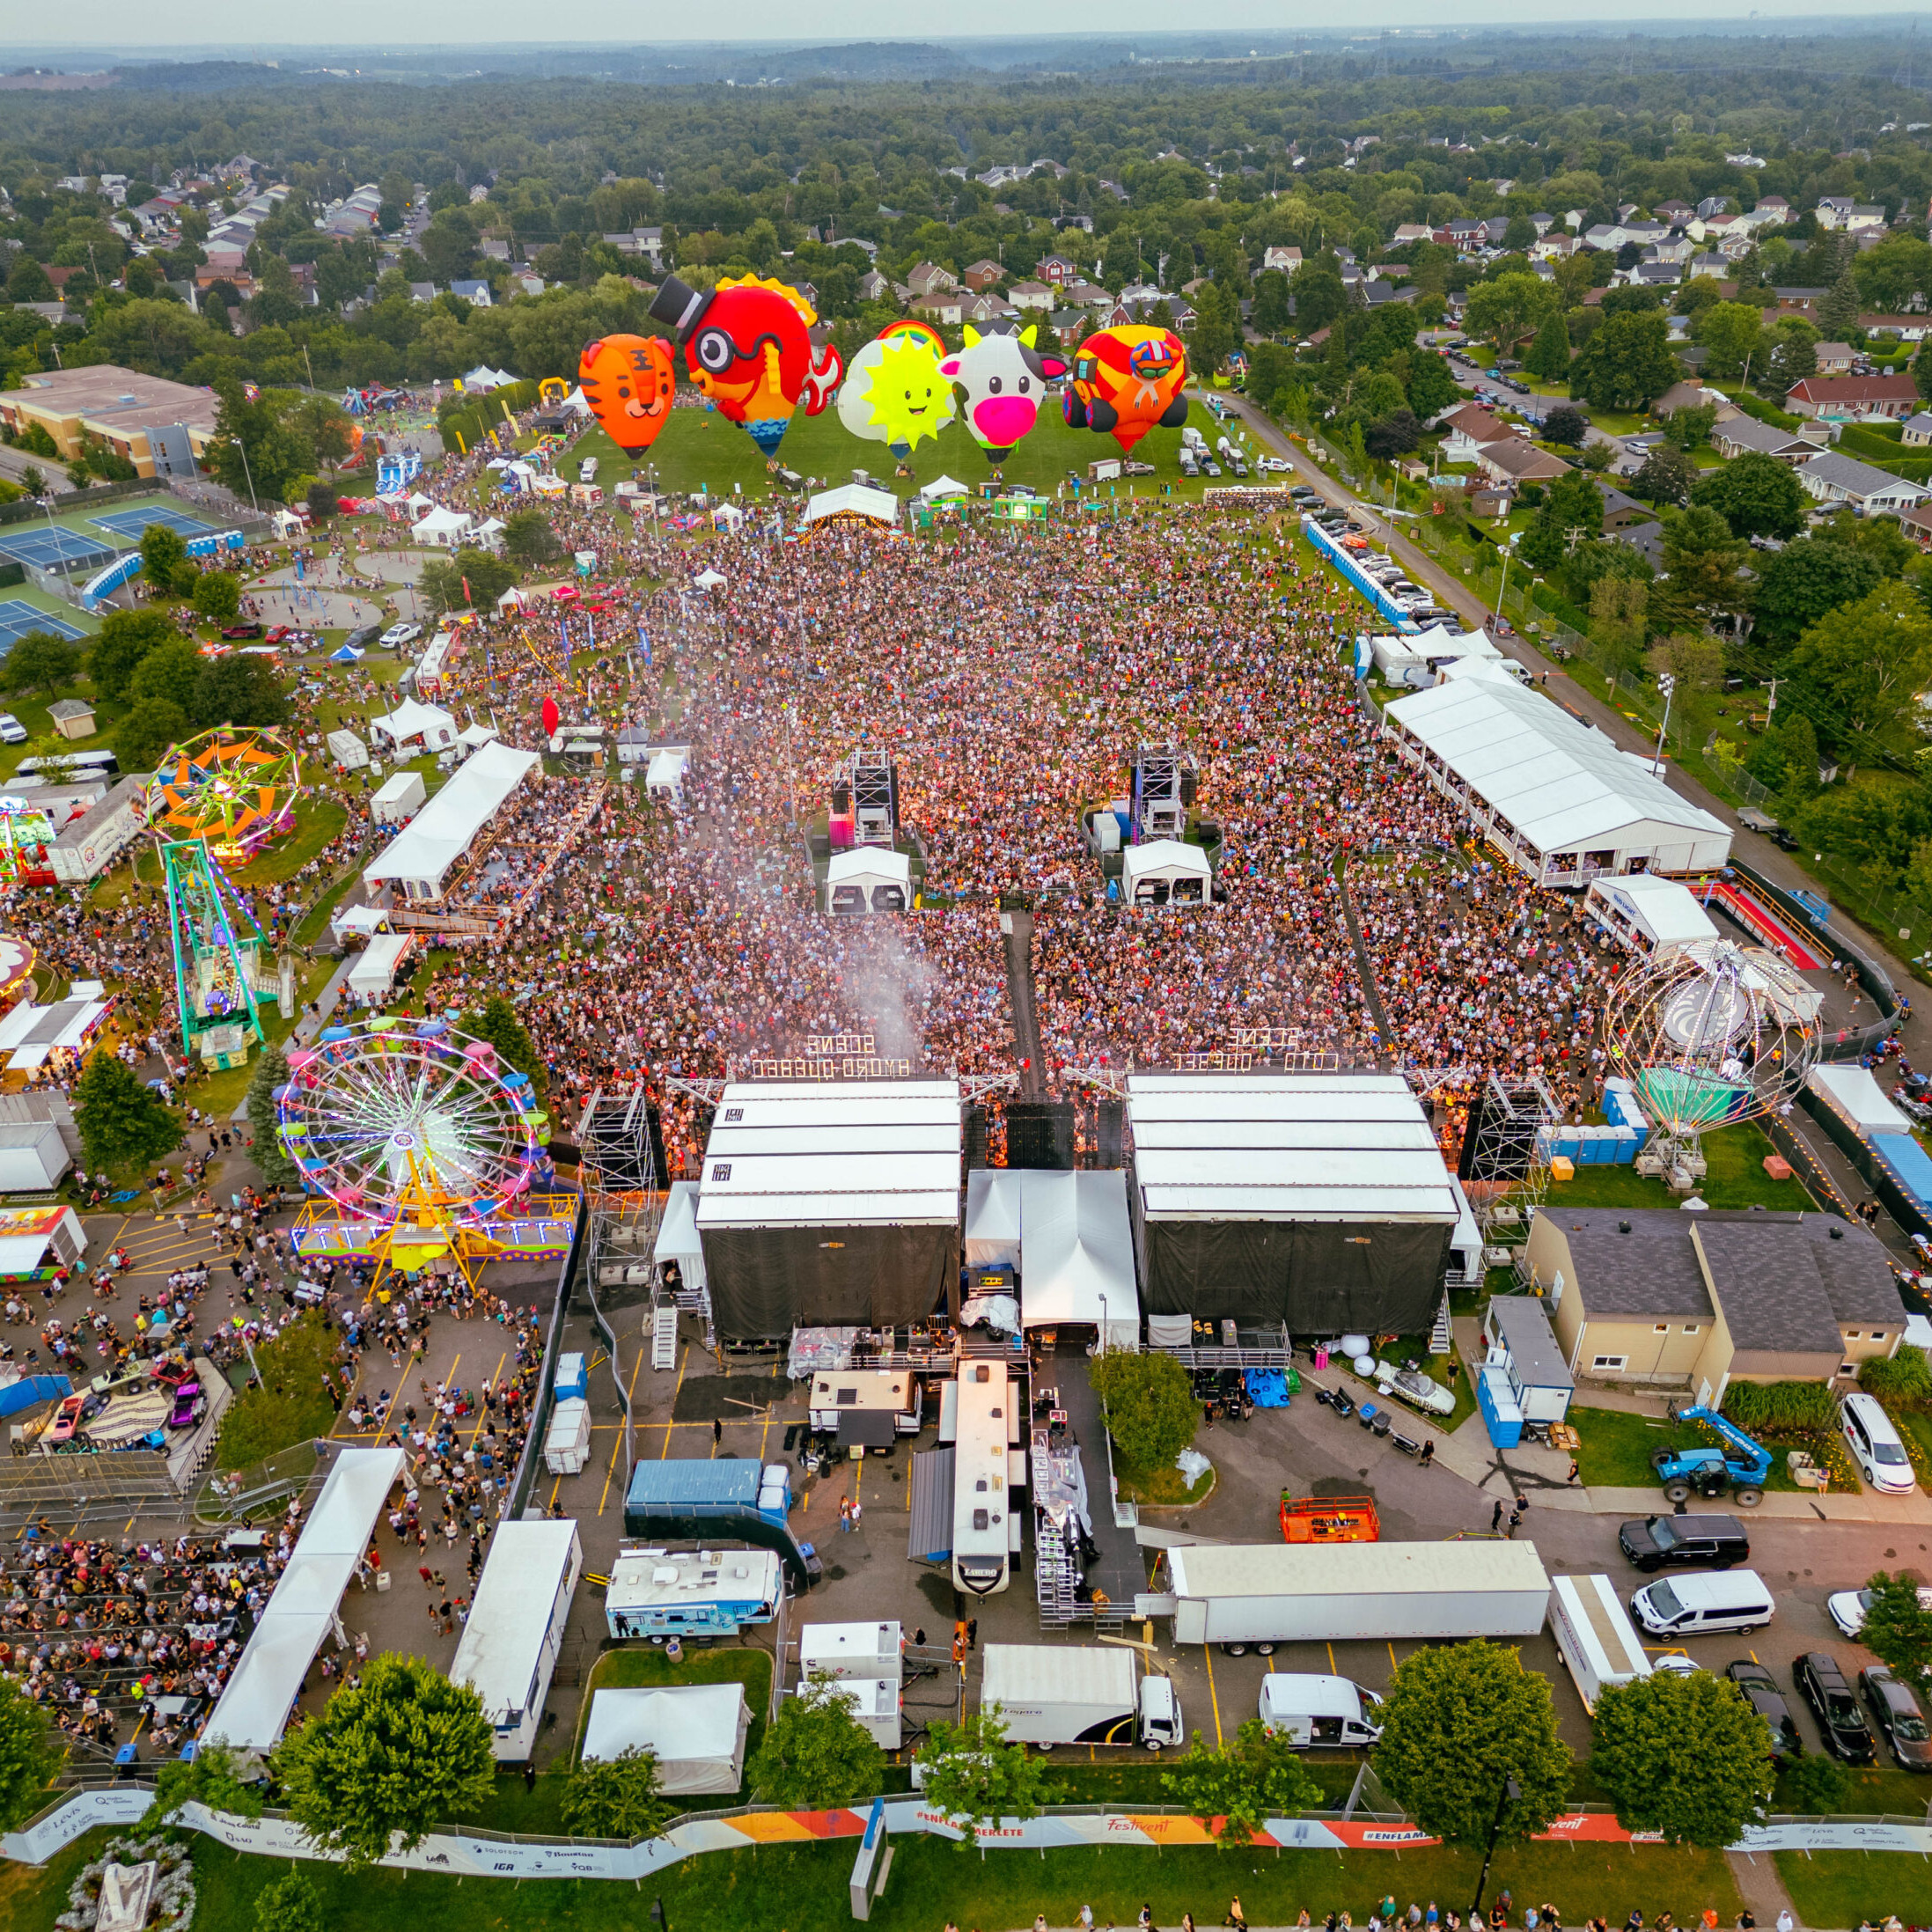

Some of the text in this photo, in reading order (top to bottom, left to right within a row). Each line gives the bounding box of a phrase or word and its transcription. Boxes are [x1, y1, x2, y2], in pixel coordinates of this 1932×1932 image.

[942, 502, 955, 511] BAR
[1107, 1818, 1173, 1833] Festivent
[494, 1862, 515, 1871] IGA
